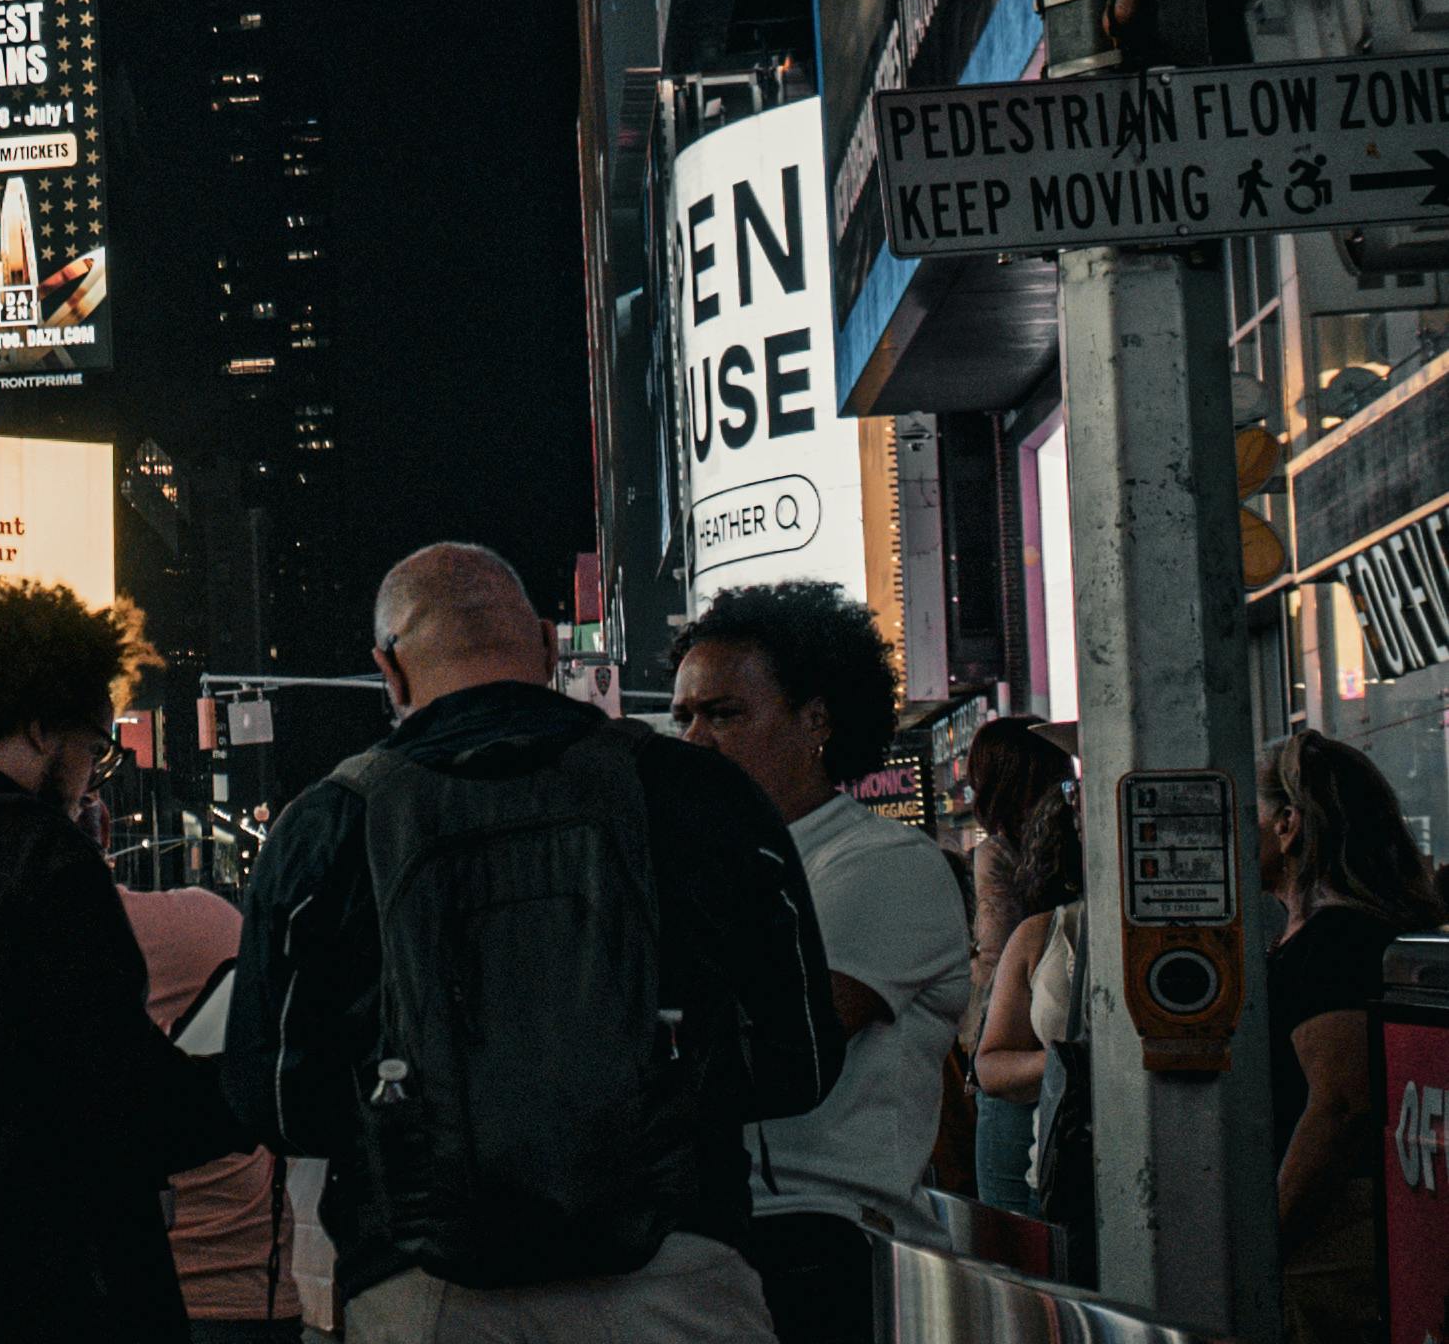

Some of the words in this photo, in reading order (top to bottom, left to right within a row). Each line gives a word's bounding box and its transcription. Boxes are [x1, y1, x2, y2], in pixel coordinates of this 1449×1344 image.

[24, 102, 62, 127] July
[64, 101, 75, 123] 1
[889, 87, 1179, 161] PEDESTRIAN
[1193, 75, 1318, 140] FLOW
[897, 178, 1012, 241] KEEP
[1029, 163, 1211, 232] MOVING
[676, 164, 807, 328] EN
